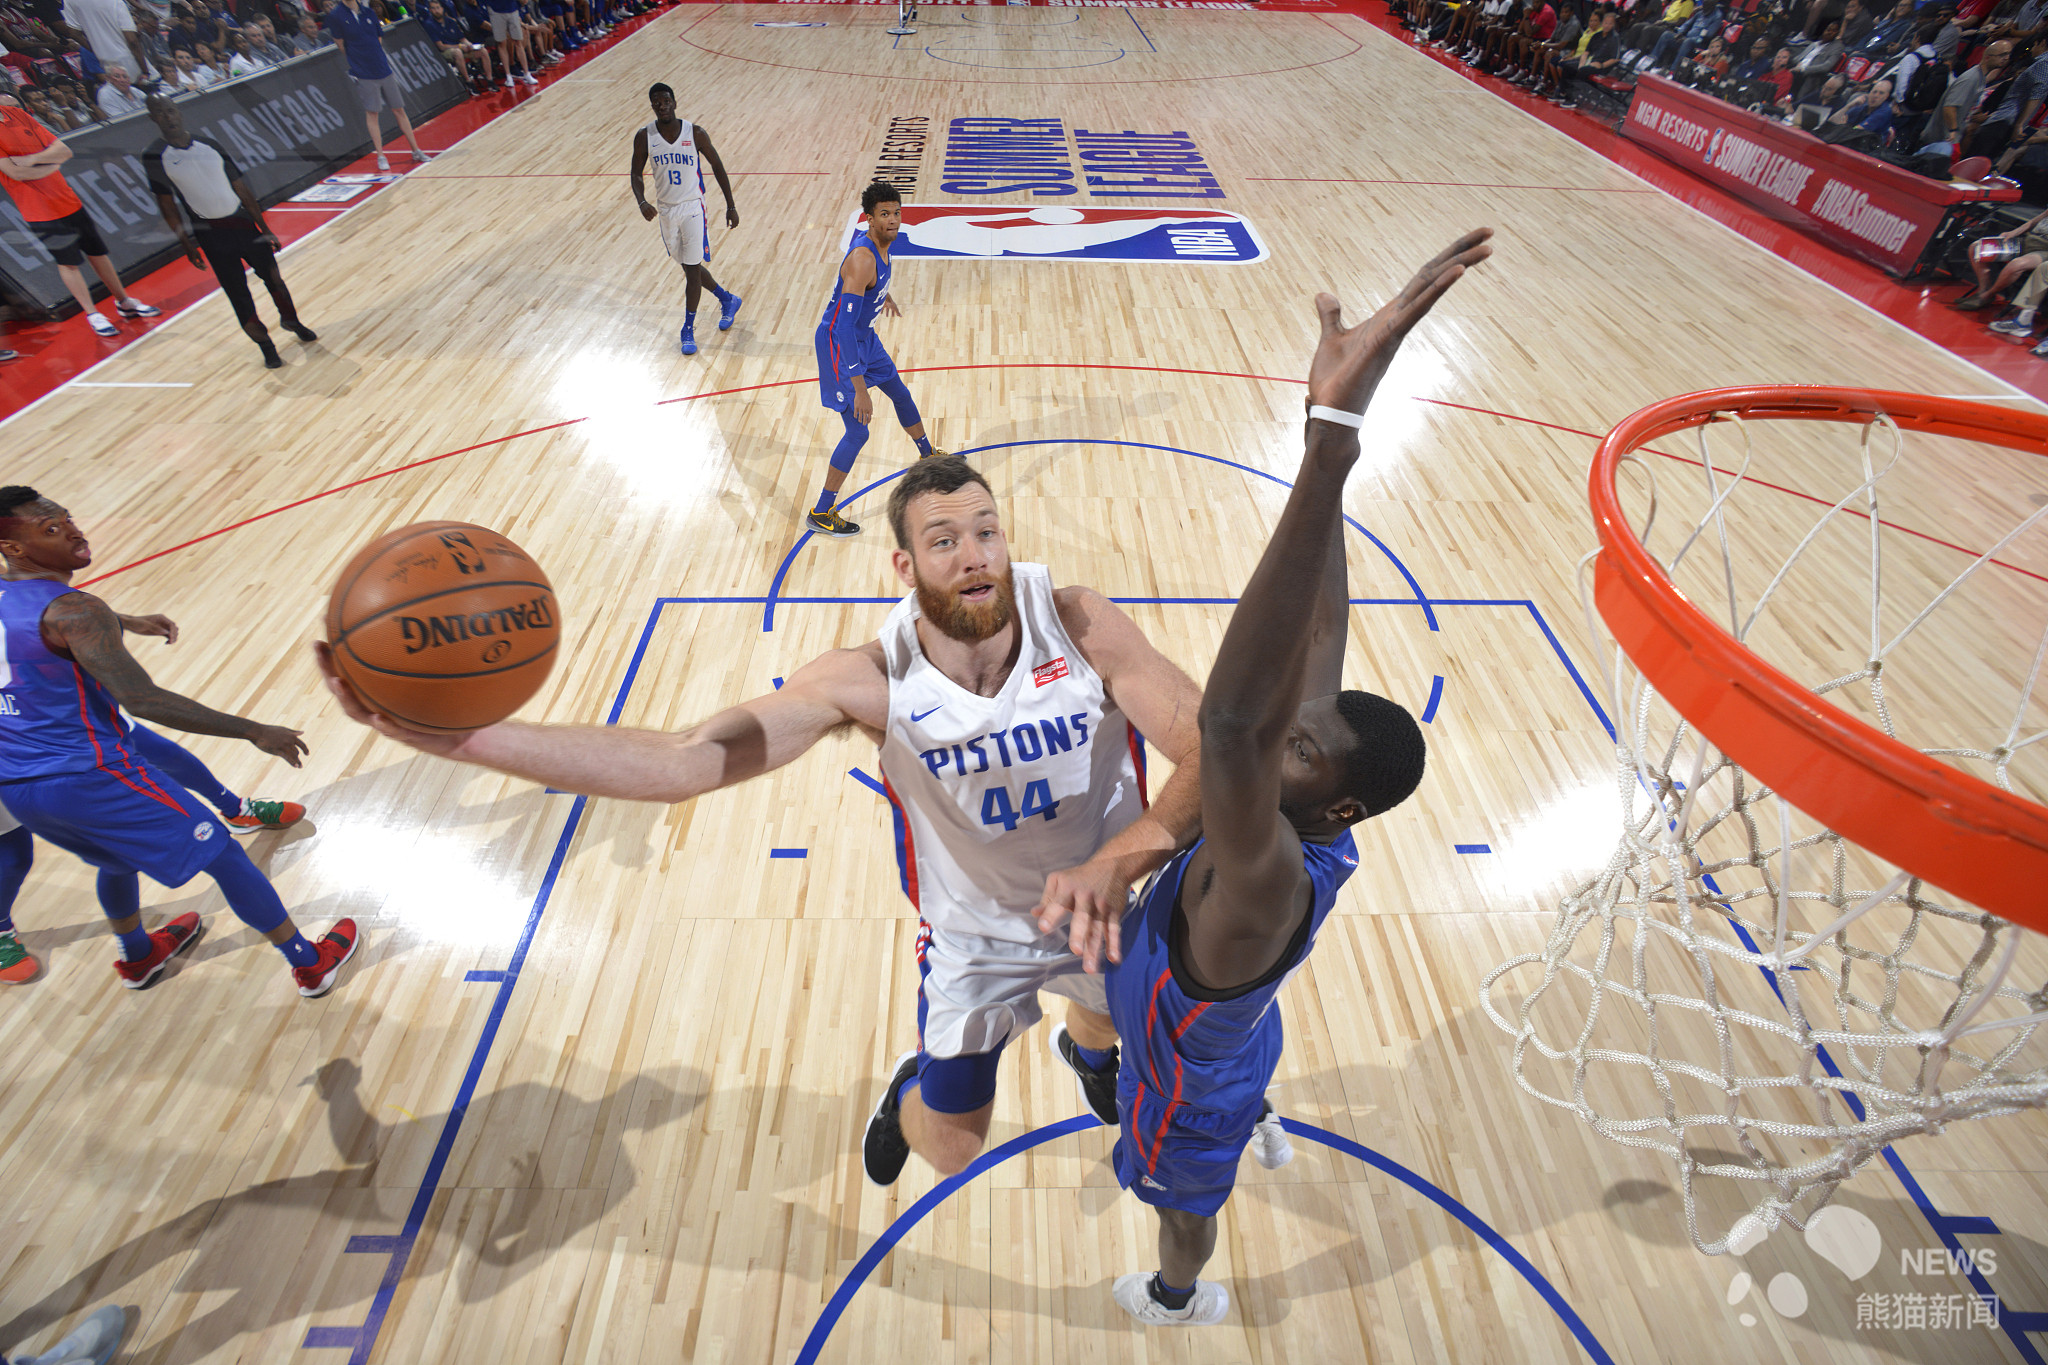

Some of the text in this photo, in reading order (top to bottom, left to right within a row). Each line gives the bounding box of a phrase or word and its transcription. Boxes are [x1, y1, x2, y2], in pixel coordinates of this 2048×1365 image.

[1048, 0, 1259, 11] SUMMER LEAGUE
[201, 84, 344, 172] LAS VEGAS
[879, 116, 930, 161] RESORTS
[653, 153, 694, 166] PISTONS
[668, 170, 682, 185] 13
[940, 117, 1078, 196] SUMMER
[1073, 129, 1227, 199] LEAGUE
[1634, 101, 1662, 130] MGM
[1658, 112, 1709, 152] RESORTS
[1714, 133, 1773, 186] SUMMER
[1758, 152, 1815, 206] LEAGUE
[1810, 178, 1918, 255] #NBASummer
[1166, 228, 1240, 256] NBA
[400, 596, 553, 654] SPALDING
[1034, 660, 1066, 678] Flagstar
[919, 712, 1089, 780] PISTONS
[980, 778, 1061, 831] 44
